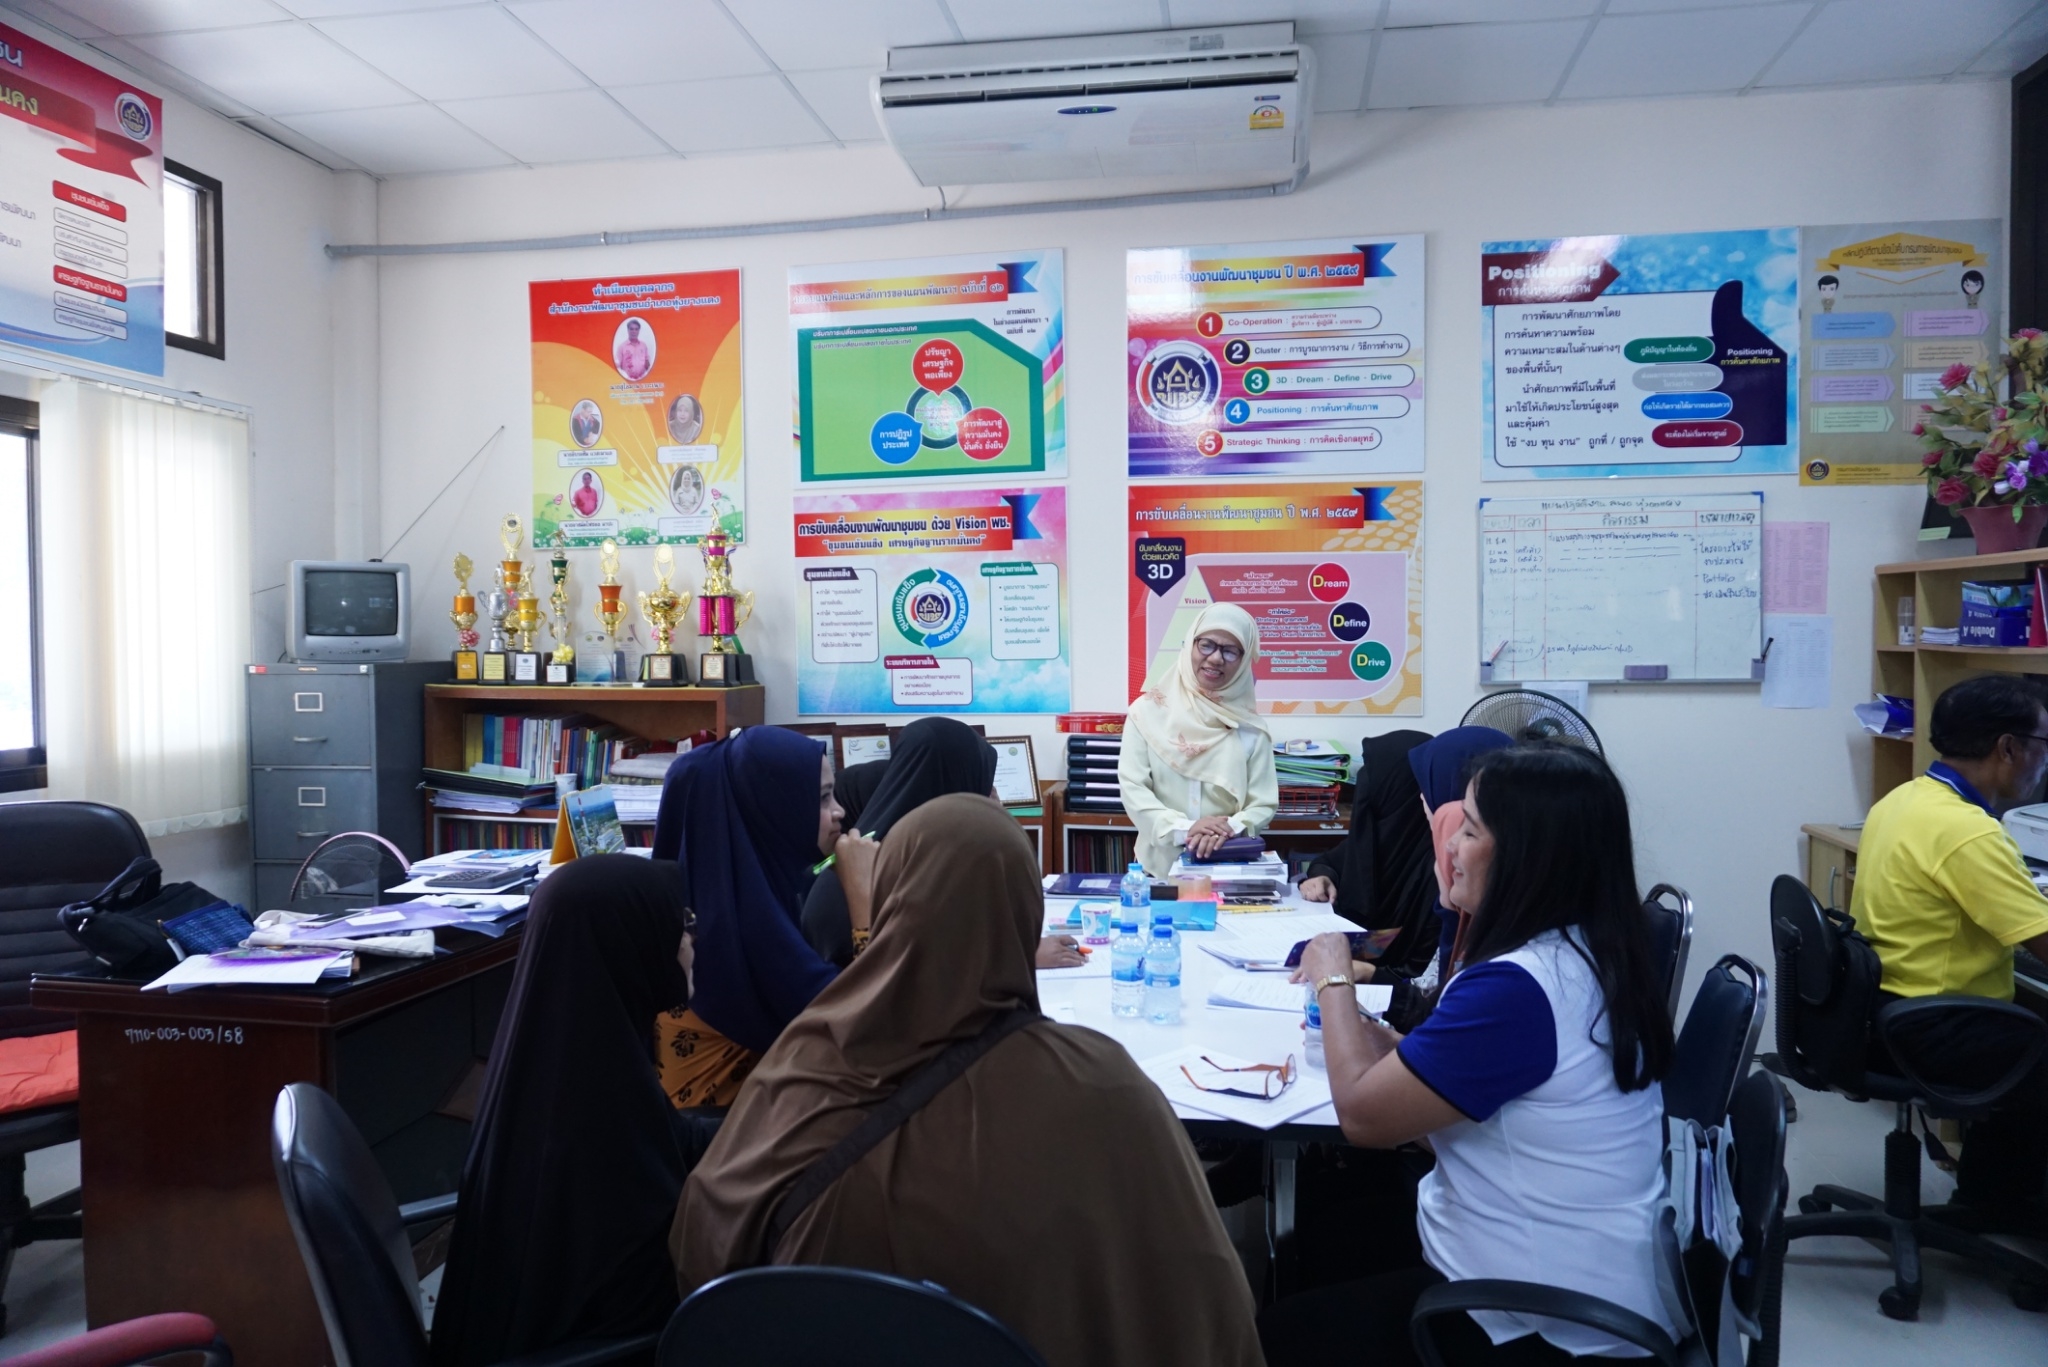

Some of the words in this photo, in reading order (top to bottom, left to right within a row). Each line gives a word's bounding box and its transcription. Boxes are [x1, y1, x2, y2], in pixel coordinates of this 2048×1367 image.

[1285, 264, 1294, 280] ปี
[1297, 267, 1322, 280] พ.ศ.
[1488, 263, 1601, 281] Positioning
[593, 282, 674, 298] ทำเนียบบุคลากร
[960, 276, 987, 293] ฉบับที่
[990, 282, 1004, 293] ๑๒
[549, 295, 721, 314] สำนักงานพัฒนาชุมชนอำเภอทุ่งยางแดง
[1522, 306, 1621, 321] การพัฒนาศักยภาพโดย
[1205, 316, 1214, 332] 1
[1228, 316, 1284, 327] Co-Operation
[1504, 325, 1595, 341] การค้นหาความพร้อม
[924, 347, 951, 358] ปรัชญา
[1231, 343, 1243, 359] 2
[1254, 346, 1281, 354] Cluster
[1289, 342, 1349, 357] การบูรณาการงาน
[1357, 340, 1404, 352] วิธีการทำงาน
[1504, 342, 1621, 358] ความเหมาะสมในด้านต่างๆ
[1727, 347, 1773, 357] Positioning
[922, 359, 954, 370] เศรษฐกิจ
[1505, 361, 1563, 376] ของพื้นที่นั้นๆ
[924, 370, 953, 379] พอเพียง
[1251, 372, 1263, 389] 3
[1334, 374, 1361, 382] Define
[1522, 379, 1616, 395] นำศักยภาพที่มีในพื้นที่
[1230, 403, 1243, 419] 4
[1257, 406, 1302, 417] Positioning
[1311, 402, 1379, 414] การค้นหาศักยภาพ
[1505, 398, 1620, 415] มาใช้ให้เกิดประโยชน์สูงสุด
[1507, 416, 1550, 432] และคุ้มค่า
[879, 428, 912, 441] การปฏิรูป
[964, 428, 1002, 440] ความมั่นคง
[1227, 437, 1263, 448] Strategic
[1266, 436, 1301, 448] Thinking
[1309, 432, 1375, 446] การคิดเชิงกลยุทธ์
[1505, 434, 1517, 448] ใช้
[1541, 436, 1556, 450] ทุน
[1589, 433, 1608, 450] ถูกที่
[1619, 433, 1644, 450] ถูกจุด
[882, 440, 910, 450] ประเทศ
[985, 439, 1004, 450] ยั่งยืน
[1204, 436, 1216, 452] 5
[1135, 503, 1284, 524] การขับเคลื่อนงานพัฒนาชุมชน
[1287, 504, 1296, 519] ปี
[1300, 508, 1322, 519] พ.ศ.
[1601, 512, 1649, 527] กิจกรรม
[799, 516, 927, 537] การขับเคลื่อนงานพัฒนาชุมชน
[931, 516, 951, 531] ด้วย
[955, 517, 987, 530] Vision
[991, 516, 1011, 529] พช.
[1139, 542, 1183, 553] ขับเคลื่อนงาน
[1141, 551, 1180, 561] ด้วยแนวคิด
[806, 569, 851, 580] ชุมชนเข้มแข็ง
[1148, 564, 1174, 580] 3D
[1312, 575, 1348, 588] Dream
[1333, 615, 1368, 628] Define
[1962, 626, 1969, 637] A
[1970, 626, 1996, 638] Double
[1356, 654, 1386, 667] Drive
